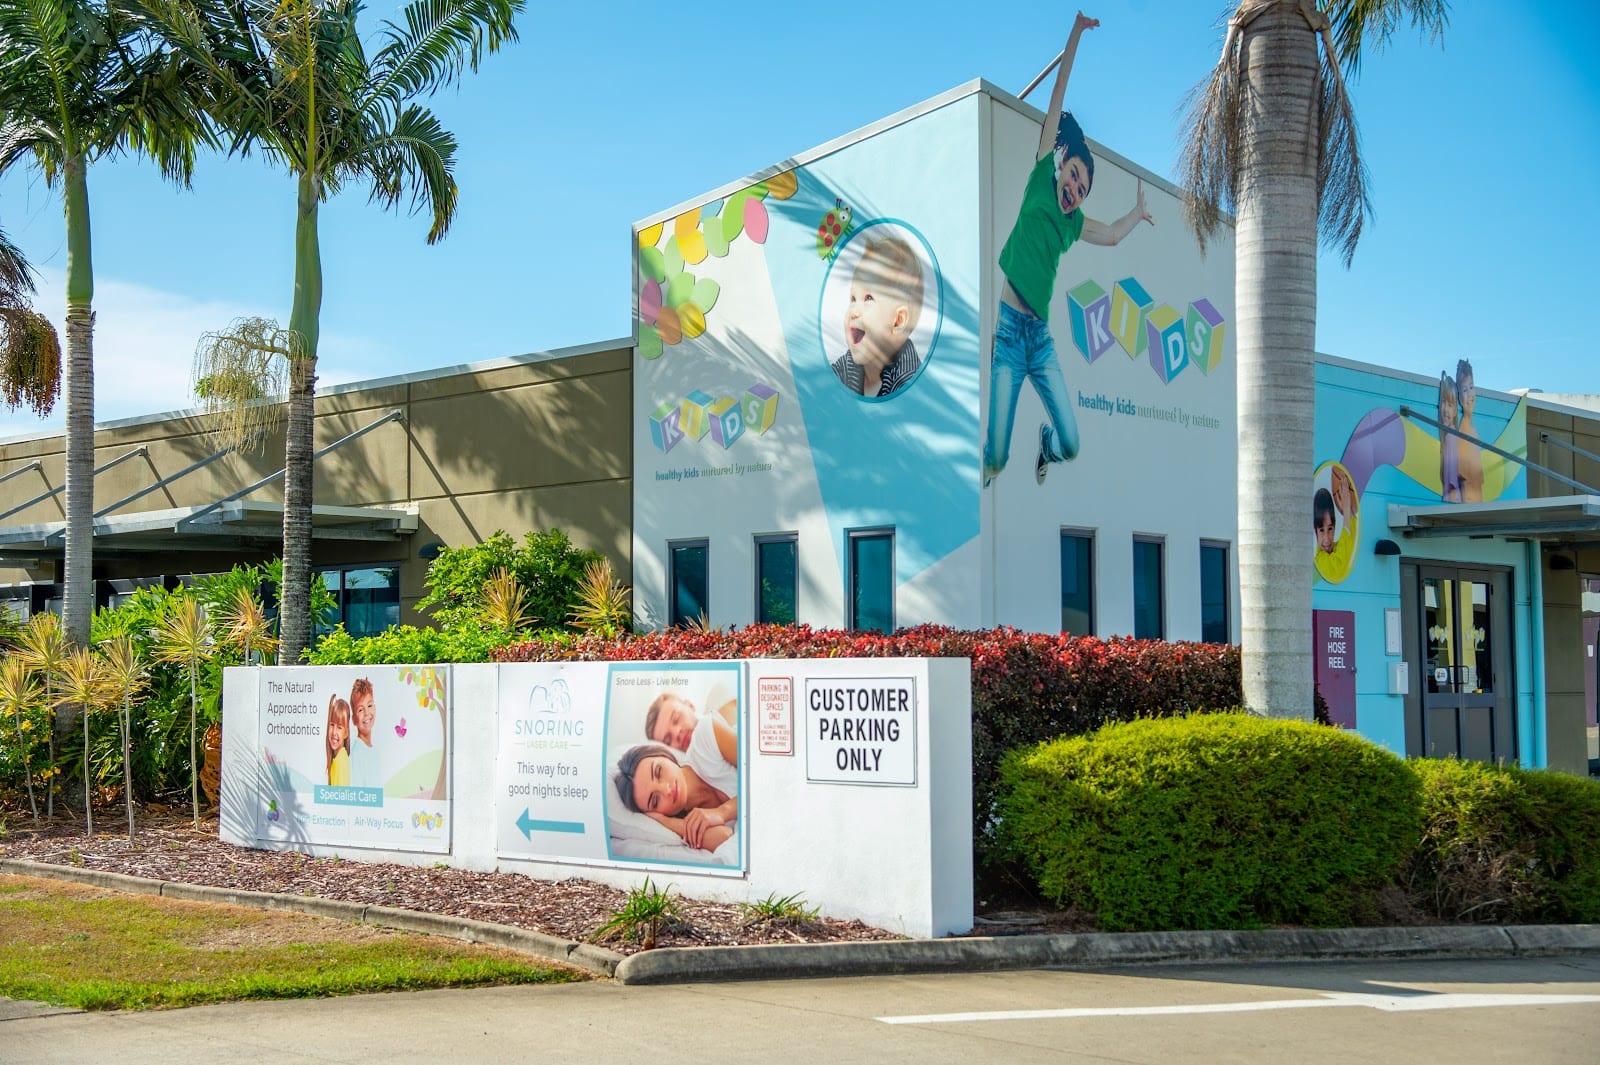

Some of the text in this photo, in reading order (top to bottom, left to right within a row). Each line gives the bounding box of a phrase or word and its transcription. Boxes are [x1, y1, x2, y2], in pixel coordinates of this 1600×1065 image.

[1087, 298, 1209, 374] KIDS
[1078, 390, 1220, 430] healthy kids nurtured by nature
[661, 397, 763, 447] KIDS
[655, 461, 772, 482] healthy kids nurtured by nature
[1329, 626, 1345, 639] FIRE
[1327, 641, 1347, 654] HOSE
[1328, 656, 1346, 669] REEL
[267, 680, 315, 693] The Natural
[615, 677, 636, 686] Snore
[636, 677, 651, 686] Less
[656, 677, 670, 686] Live
[671, 677, 689, 686] More
[809, 688, 910, 712] CUSTOMER
[267, 701, 318, 717] Approach to
[266, 722, 320, 736] Orthodontics
[515, 719, 584, 736] SNORING
[819, 717, 901, 742] PARKING
[526, 740, 569, 750] LASER CARE
[836, 747, 882, 772] ONLY
[517, 761, 578, 779] This way for a
[319, 788, 377, 803] Specialist Care
[508, 783, 589, 801] good nights sleep
[383, 817, 404, 829] Focus
